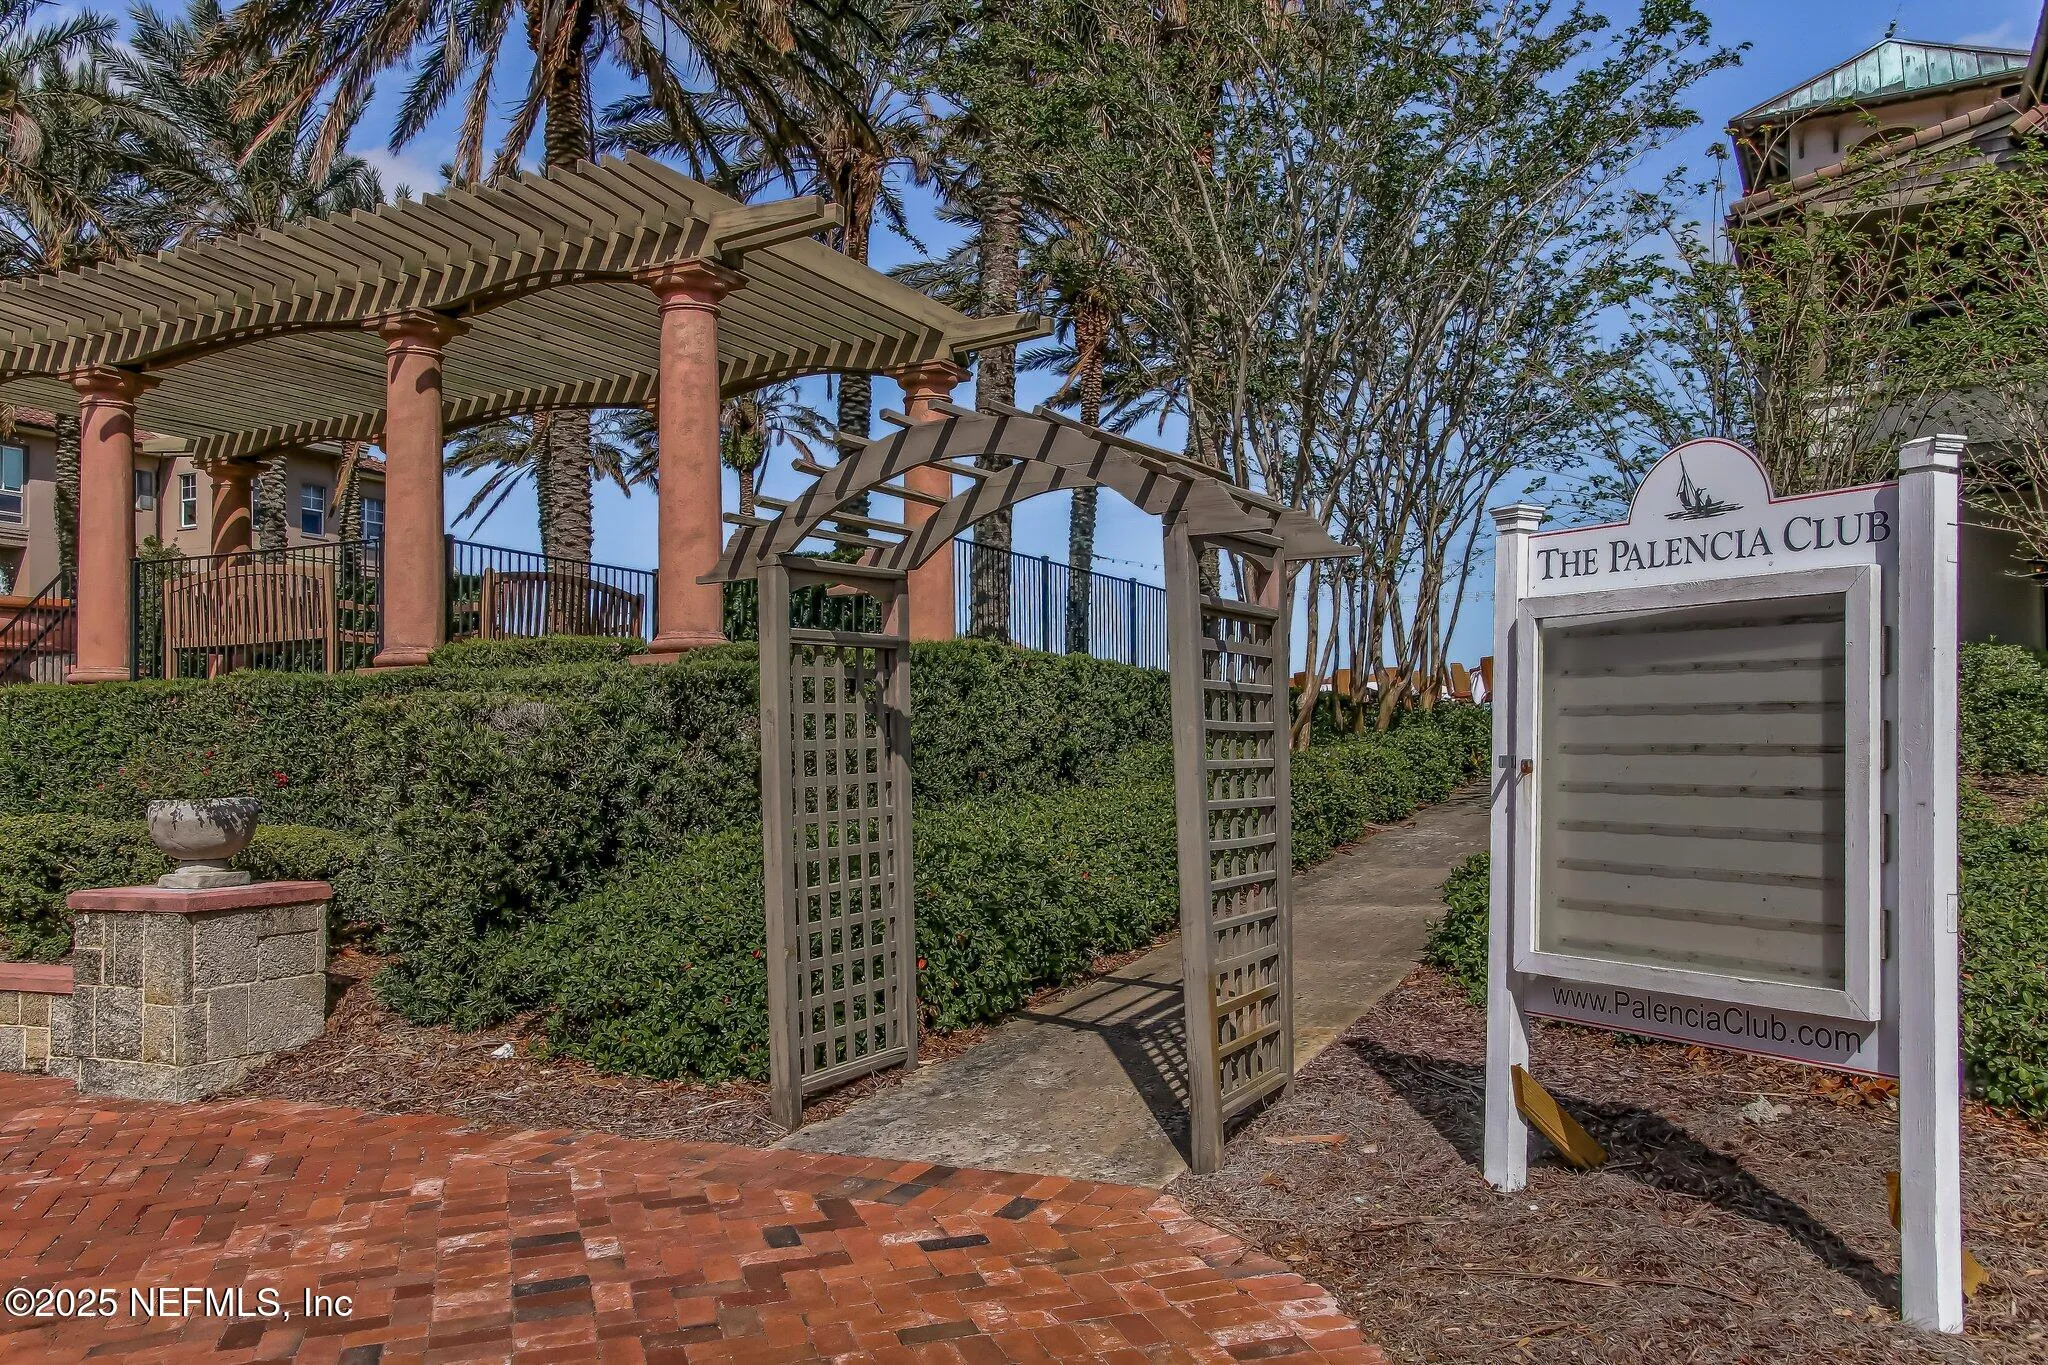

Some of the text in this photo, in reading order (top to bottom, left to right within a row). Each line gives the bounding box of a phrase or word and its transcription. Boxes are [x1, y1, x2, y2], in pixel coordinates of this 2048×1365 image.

[1537, 510, 1891, 581] THE PALENCIA CLUB
[1552, 986, 1861, 1054] www.PalenciaClub.com
